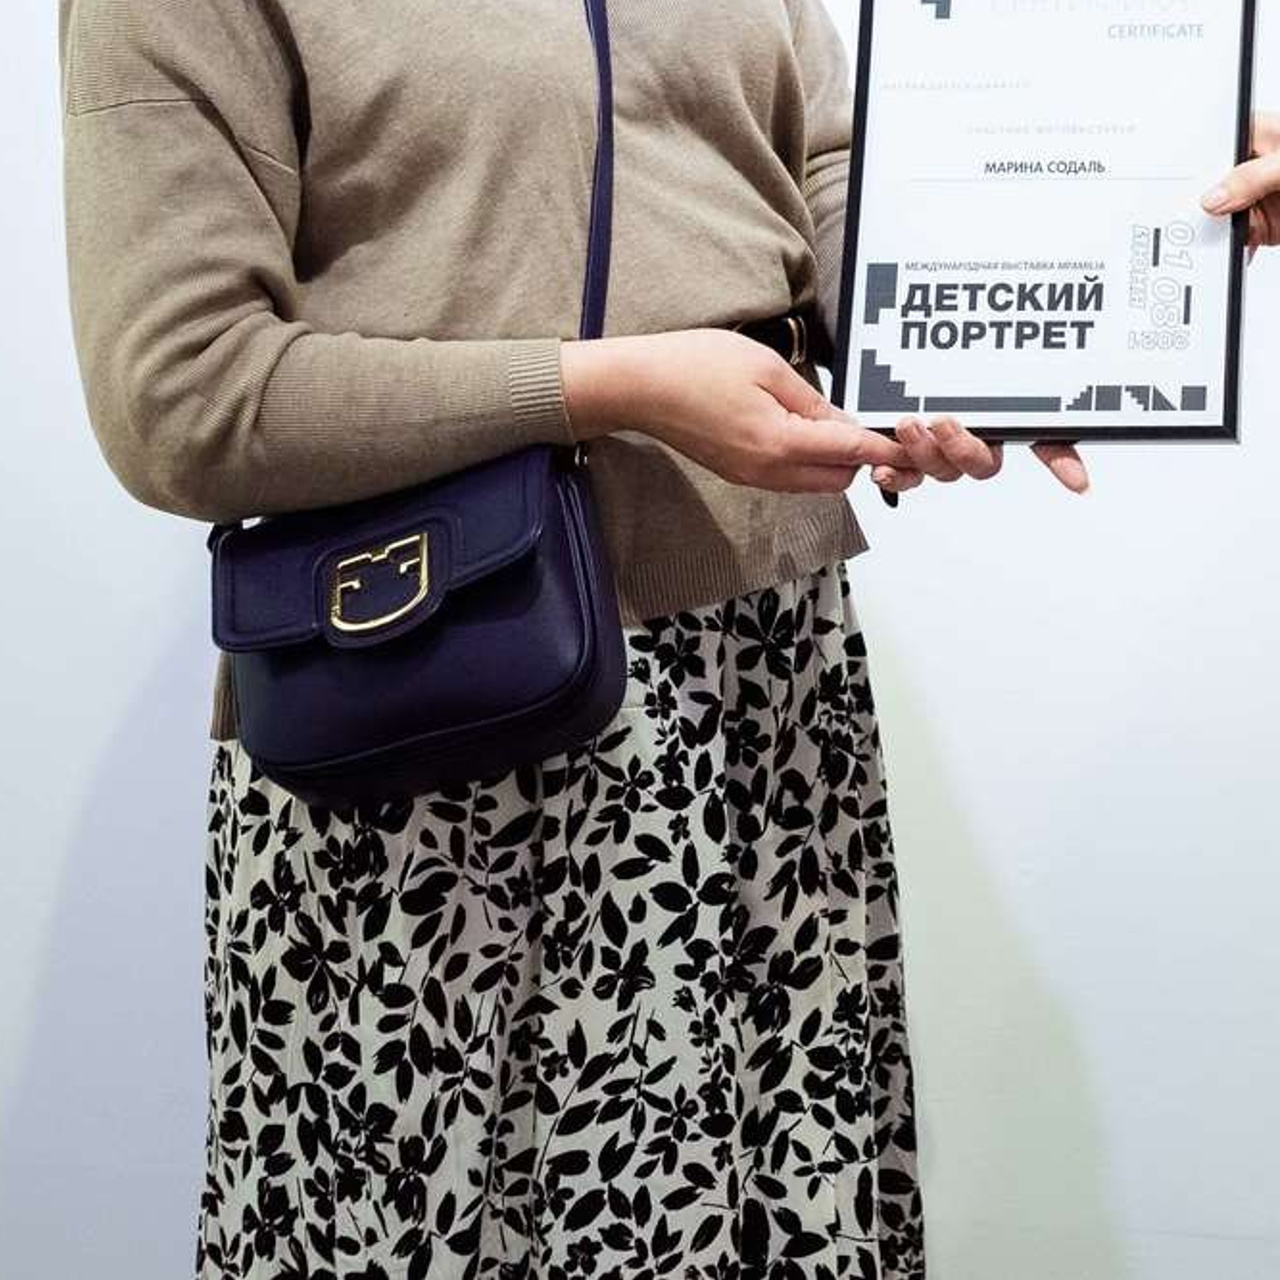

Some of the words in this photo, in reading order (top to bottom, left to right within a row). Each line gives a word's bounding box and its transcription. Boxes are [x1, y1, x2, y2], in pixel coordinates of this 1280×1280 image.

[1107, 23, 1205, 39] CERTIFICATE
[984, 160, 1043, 174] МАРИНА
[1047, 160, 1106, 175] СОДАЛЬ
[900, 275, 1104, 318] ДЕТСКИЙ
[900, 320, 1095, 350] ПОРТРЕТ
